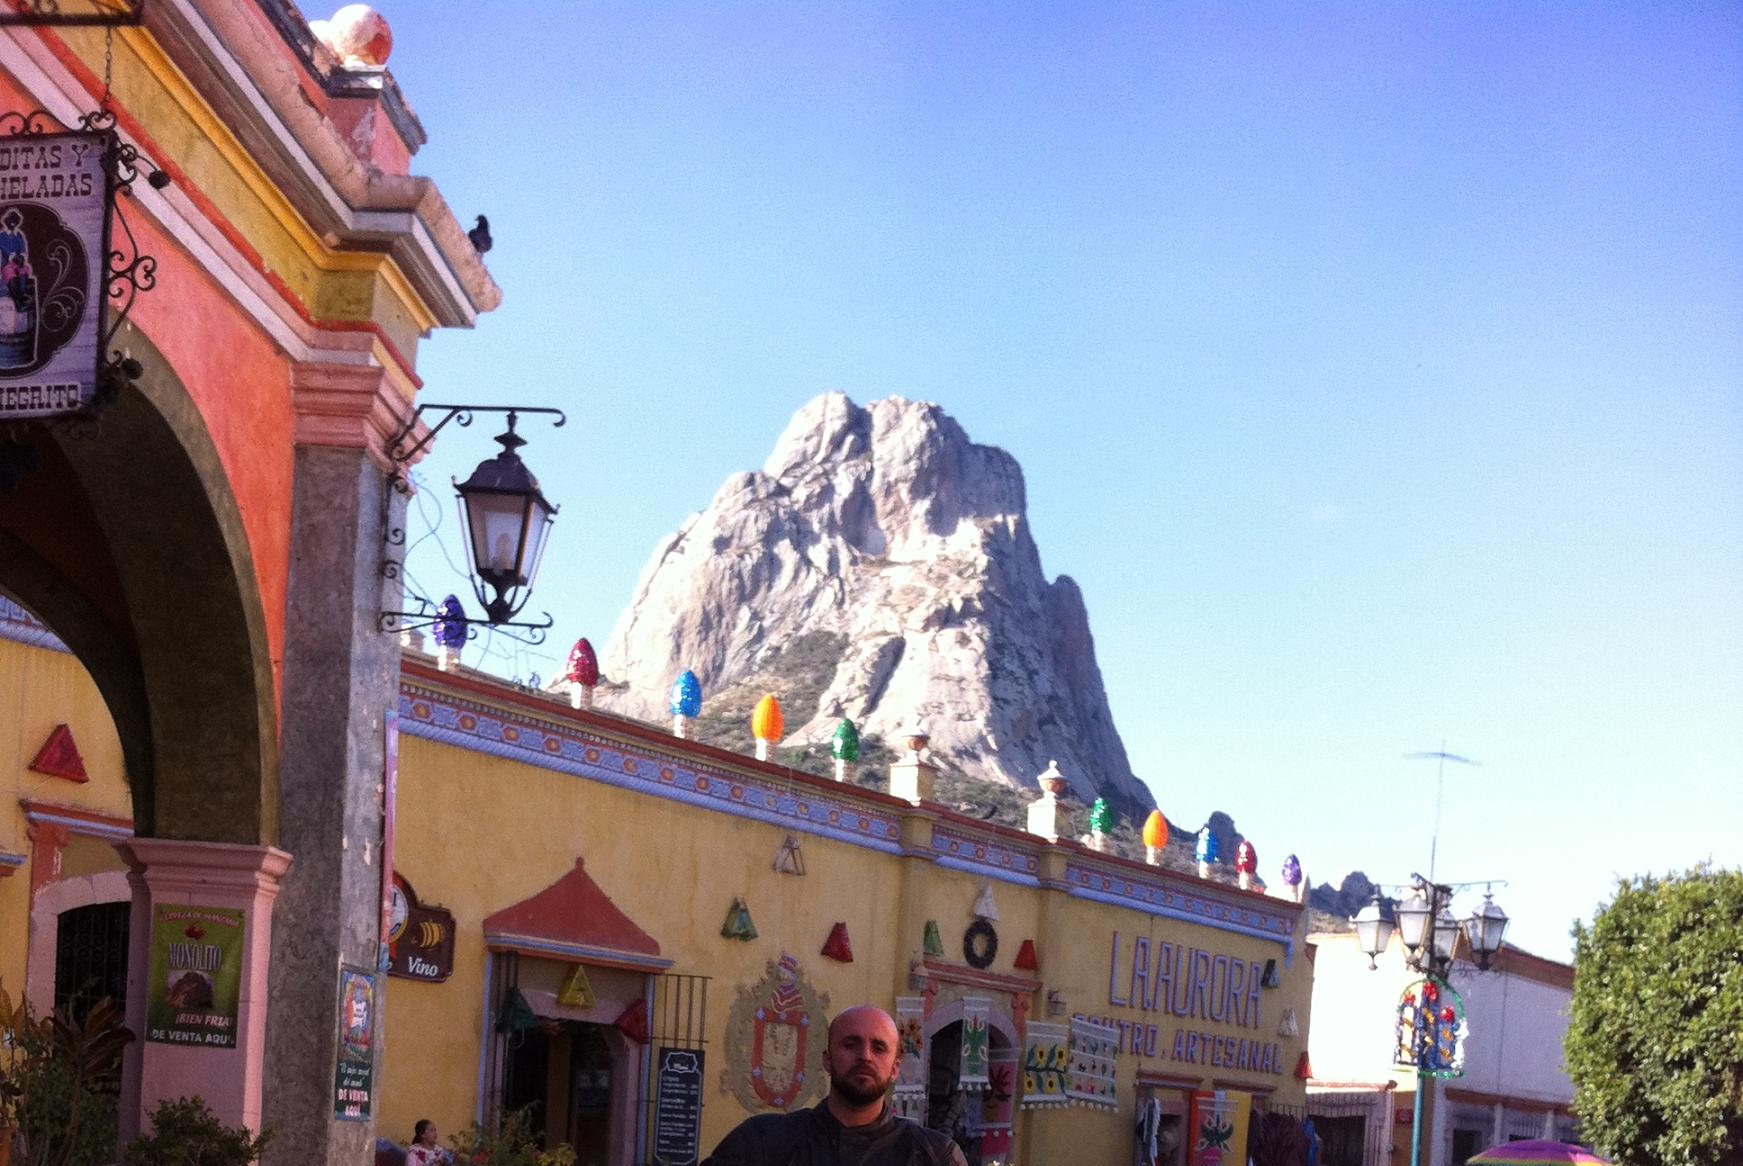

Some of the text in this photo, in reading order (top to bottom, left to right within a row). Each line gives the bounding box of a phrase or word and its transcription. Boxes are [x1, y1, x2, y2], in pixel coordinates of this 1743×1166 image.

[71, 143, 89, 168] Y
[168, 943, 222, 971] MONOLITO
[407, 956, 439, 977] Vino
[1109, 930, 1263, 1030] LA AURORA
[152, 1029, 165, 1040] DE
[168, 1031, 202, 1043] VENTA
[1171, 1029, 1284, 1076] ARTESANAL
[338, 1089, 369, 1102] DE VENTA
